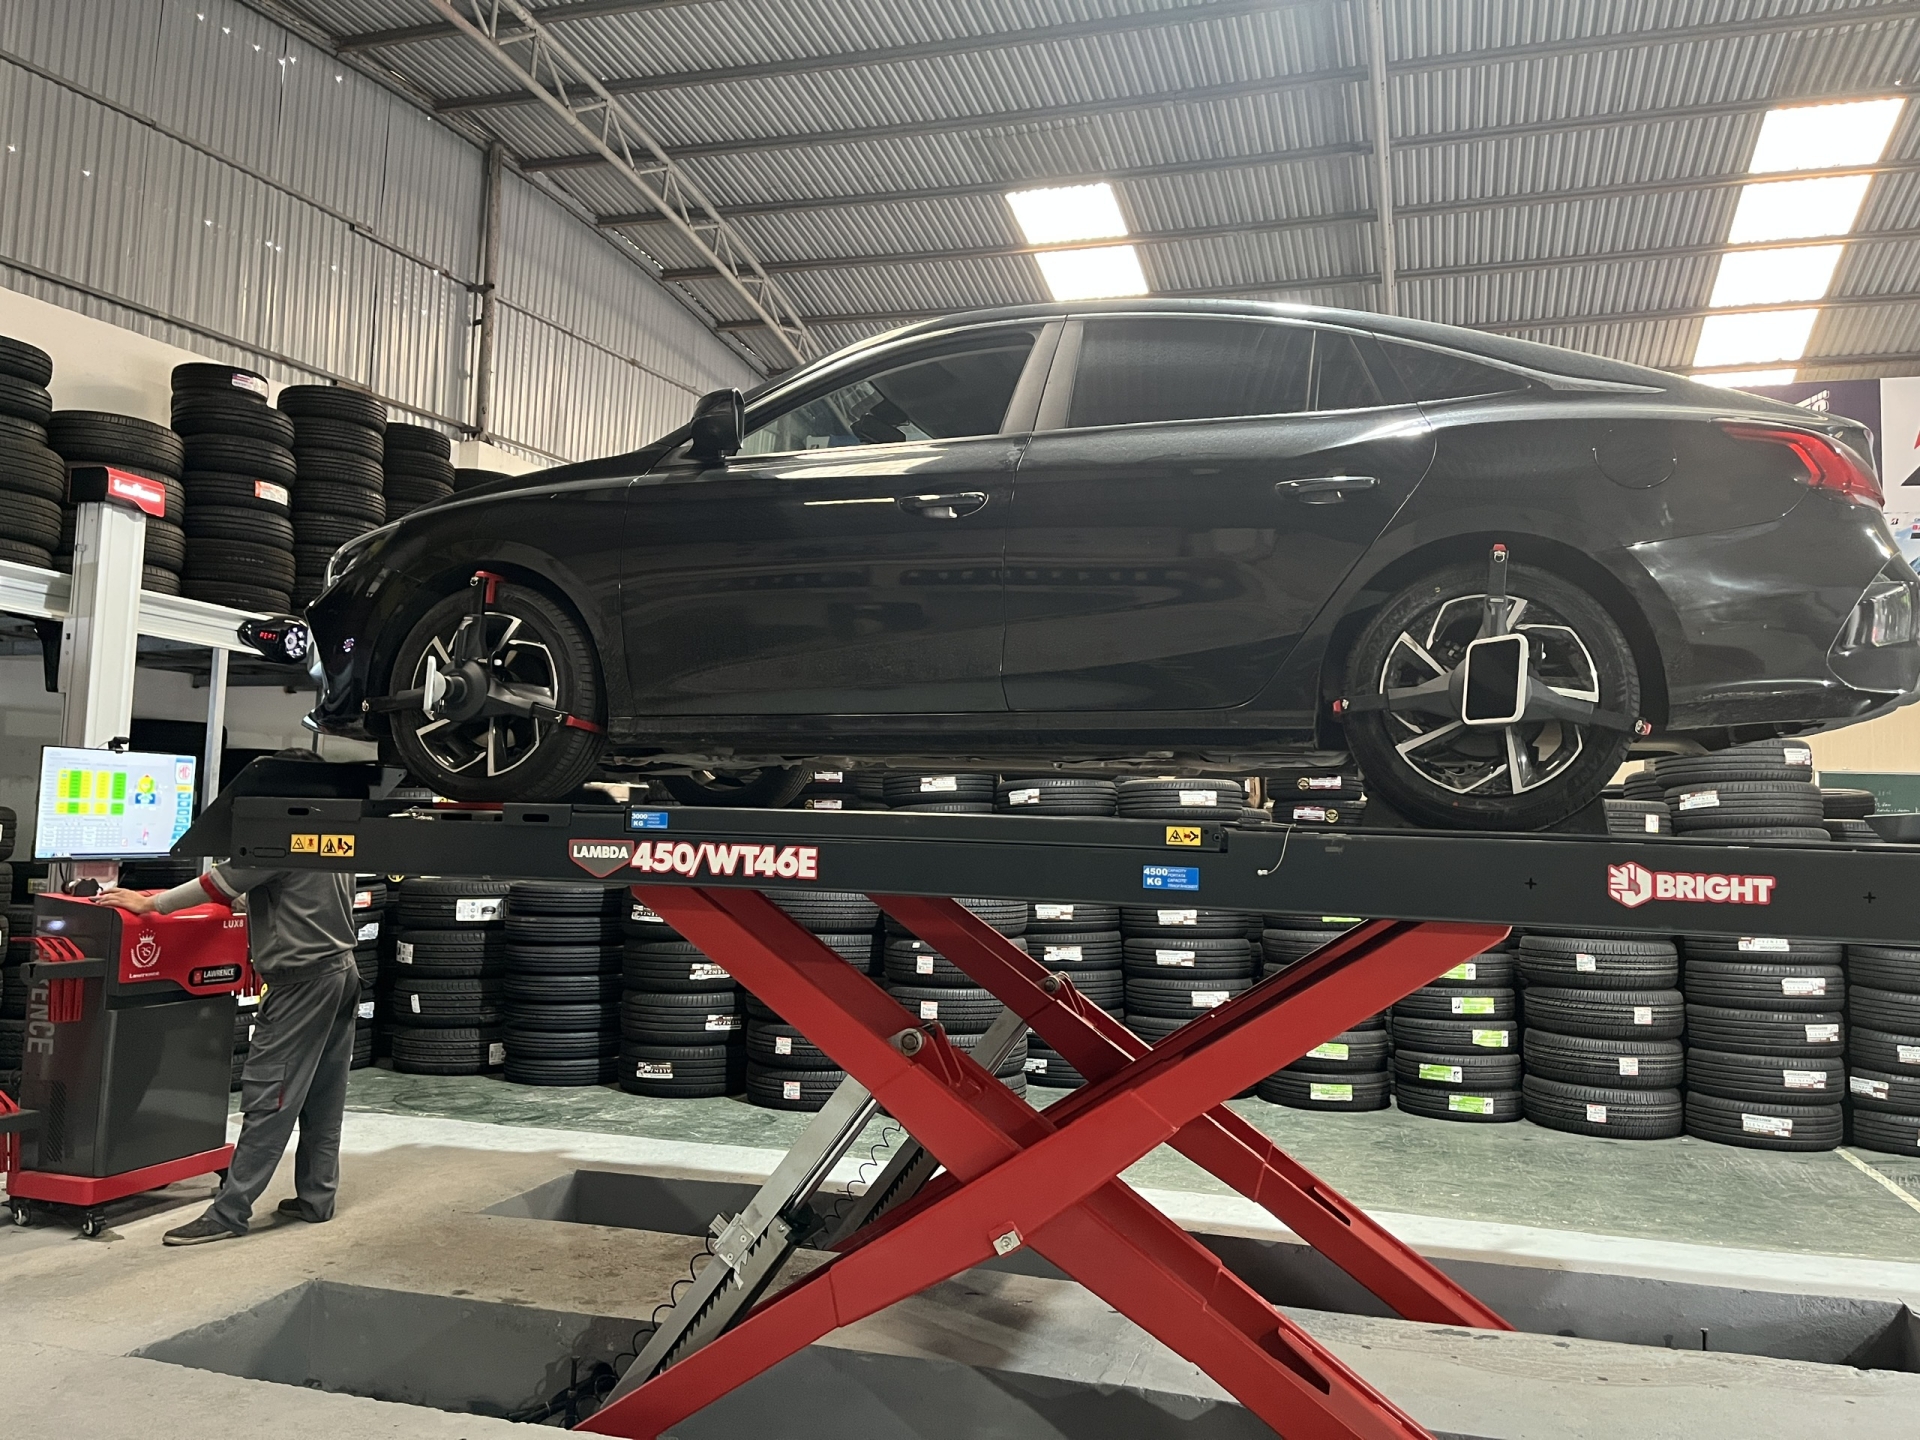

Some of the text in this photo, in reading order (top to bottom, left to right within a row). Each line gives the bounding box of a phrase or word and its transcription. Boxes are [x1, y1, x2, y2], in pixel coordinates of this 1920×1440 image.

[573, 841, 818, 879] LAMBDA 450/WT46E
[1143, 867, 1168, 876] 4500
[1147, 877, 1162, 886] KG
[1656, 874, 1773, 903] BRIGHT
[223, 919, 244, 929] LUX8
[203, 968, 235, 979] LAWRENCE
[27, 915, 63, 1056] LENCE
